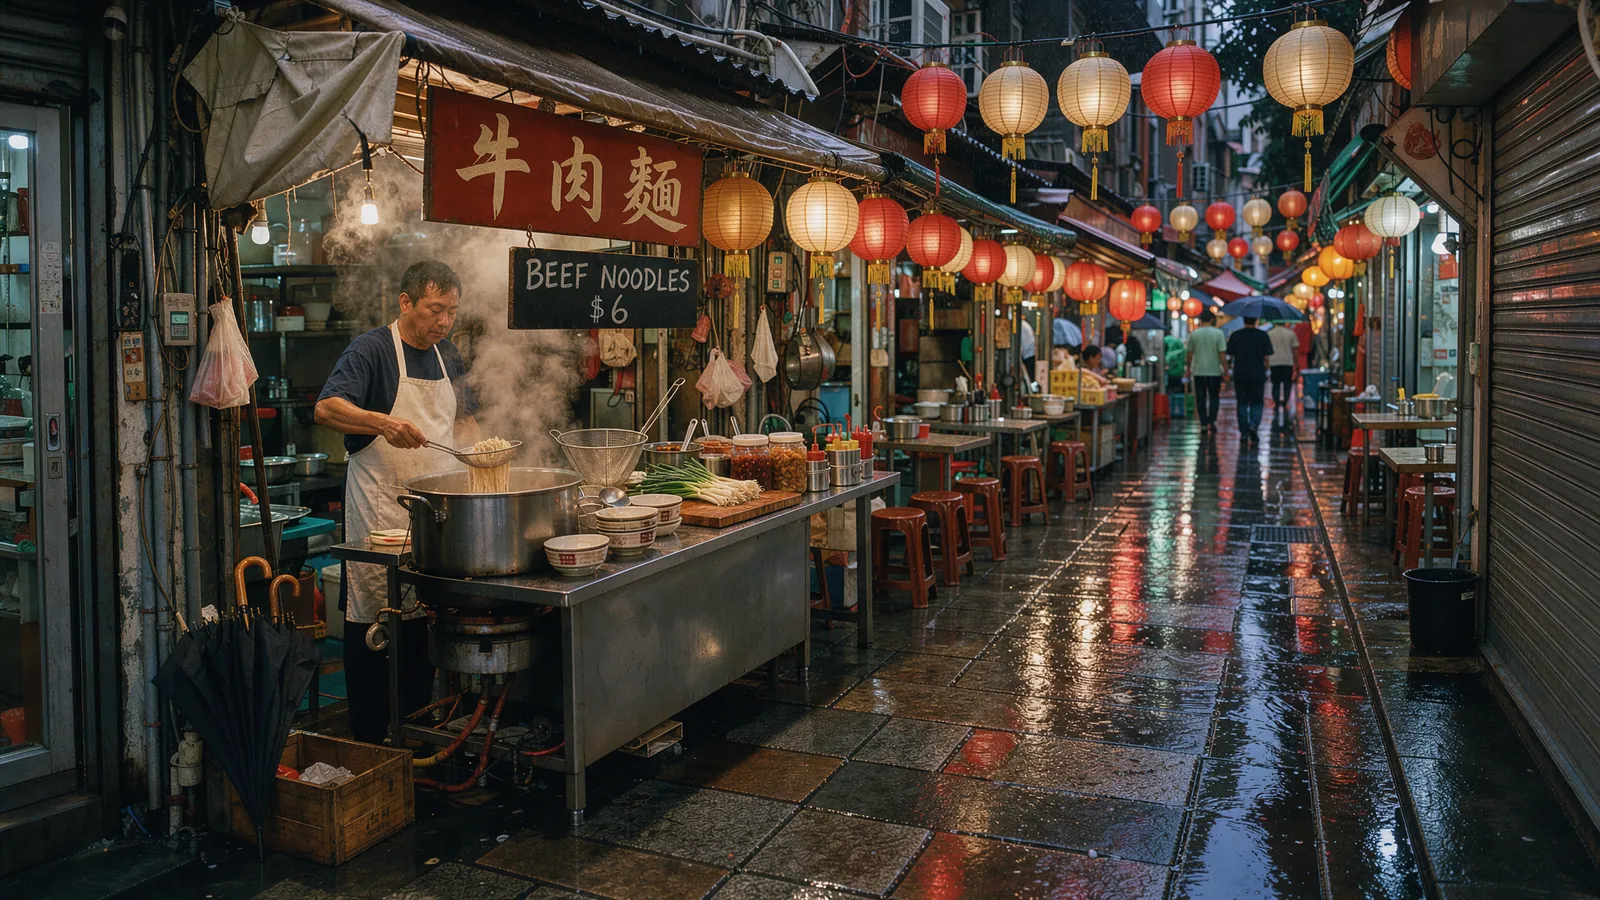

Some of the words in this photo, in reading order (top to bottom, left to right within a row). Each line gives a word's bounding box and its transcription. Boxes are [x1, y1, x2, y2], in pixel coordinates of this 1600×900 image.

[455, 112, 687, 233] 牛肉麵
[526, 258, 589, 290] BEEF
[600, 264, 690, 293] NOODLES
